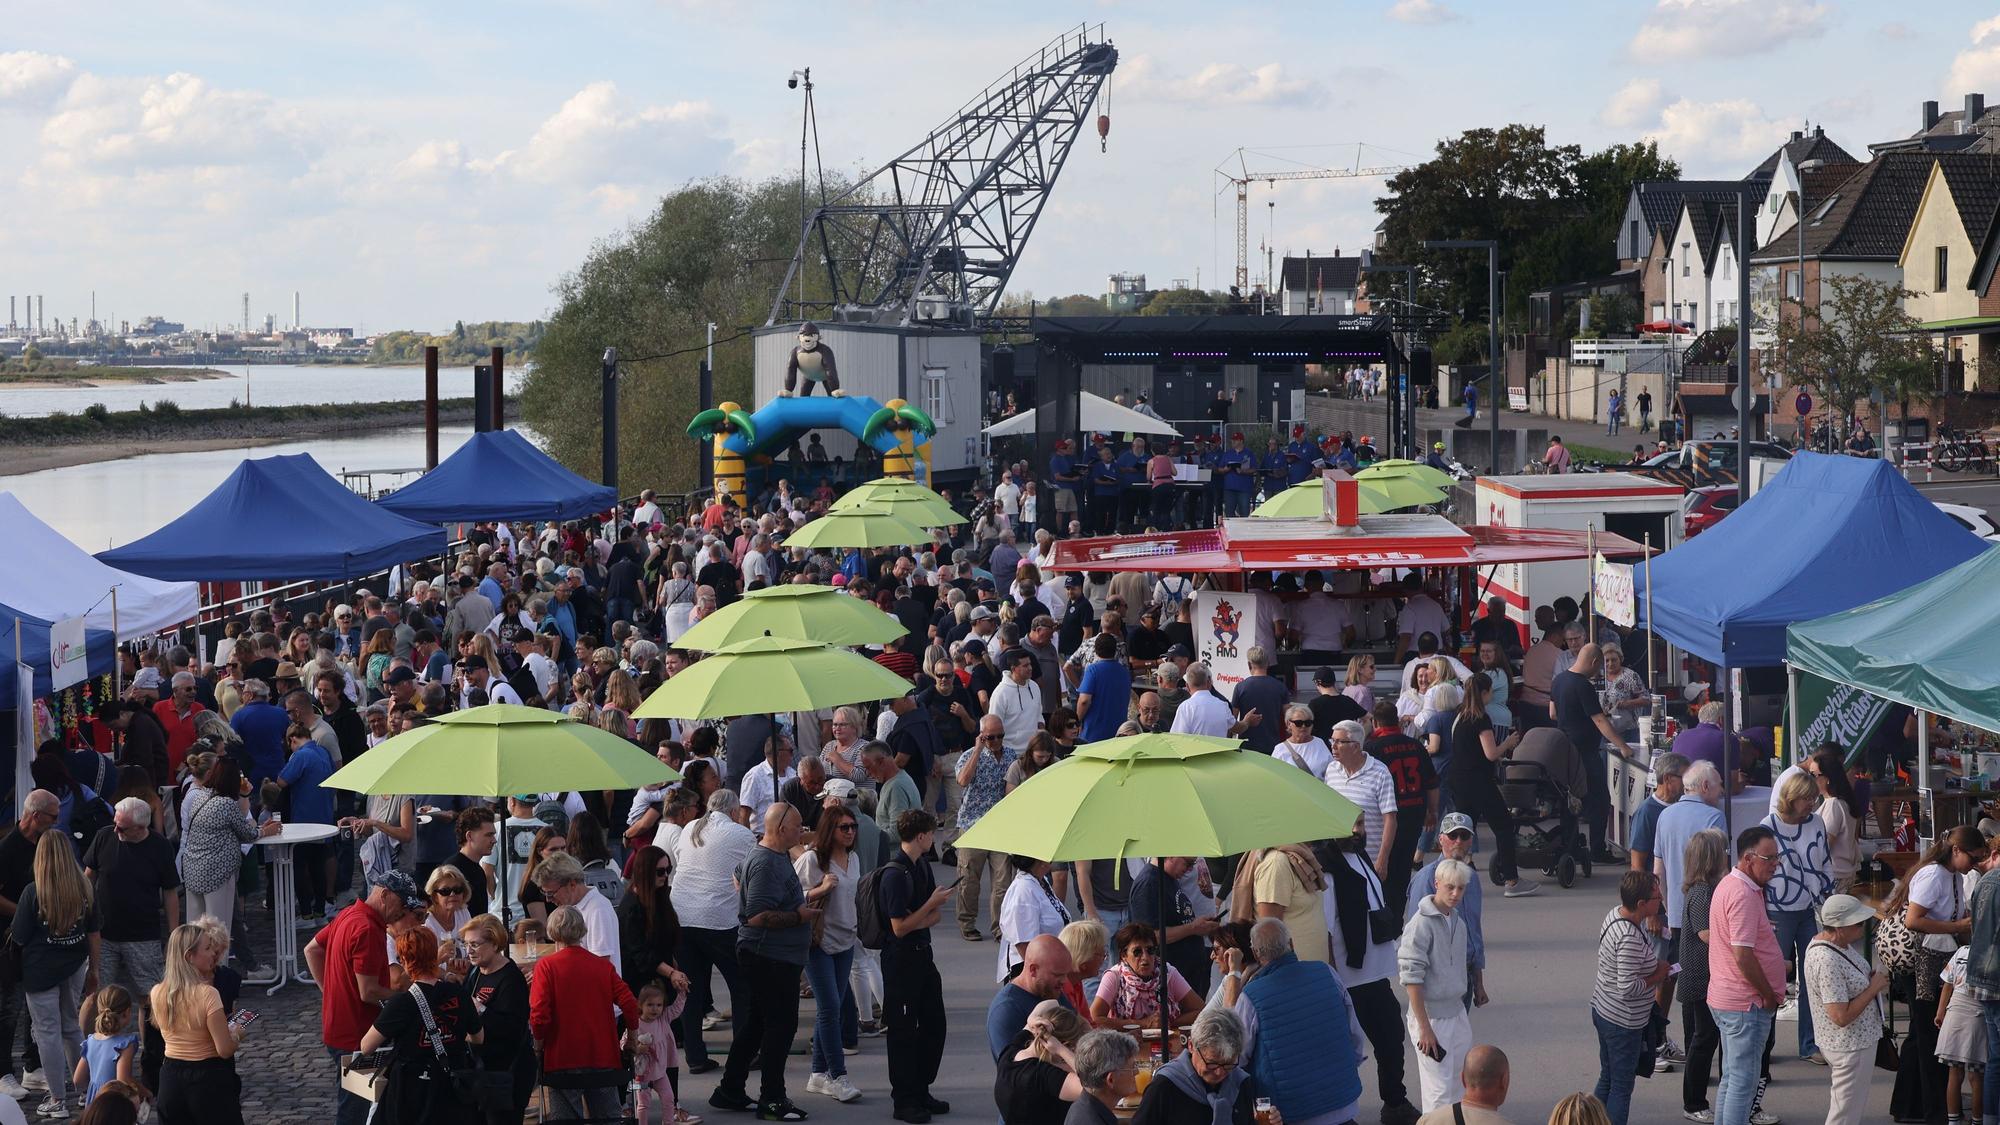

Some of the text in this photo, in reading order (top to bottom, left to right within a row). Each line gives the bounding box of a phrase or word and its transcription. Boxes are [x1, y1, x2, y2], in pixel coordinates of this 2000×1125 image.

[1338, 319, 1373, 327] smartStage
[1216, 646, 1238, 658] HMJ
[1798, 683, 1857, 762] Jungschüt
[1830, 690, 1876, 748] Hitdor
[1390, 756, 1421, 793] 13
